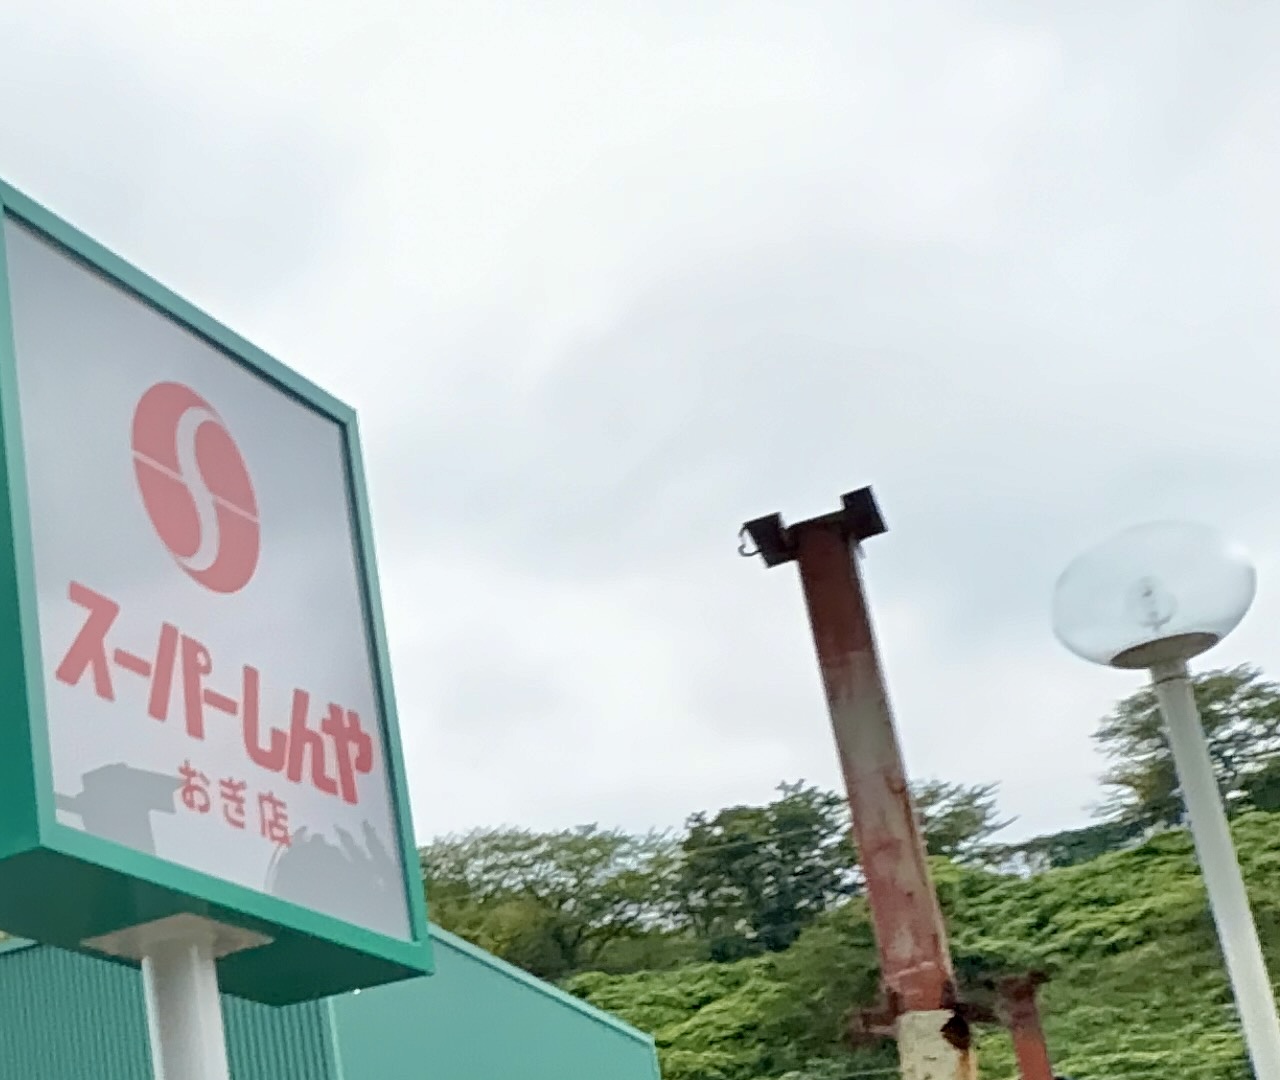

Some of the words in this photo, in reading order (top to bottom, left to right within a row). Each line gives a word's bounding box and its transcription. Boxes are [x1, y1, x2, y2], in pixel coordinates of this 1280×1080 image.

[55, 582, 374, 805] スーパーしんや
[178, 759, 292, 847] おぎ店
